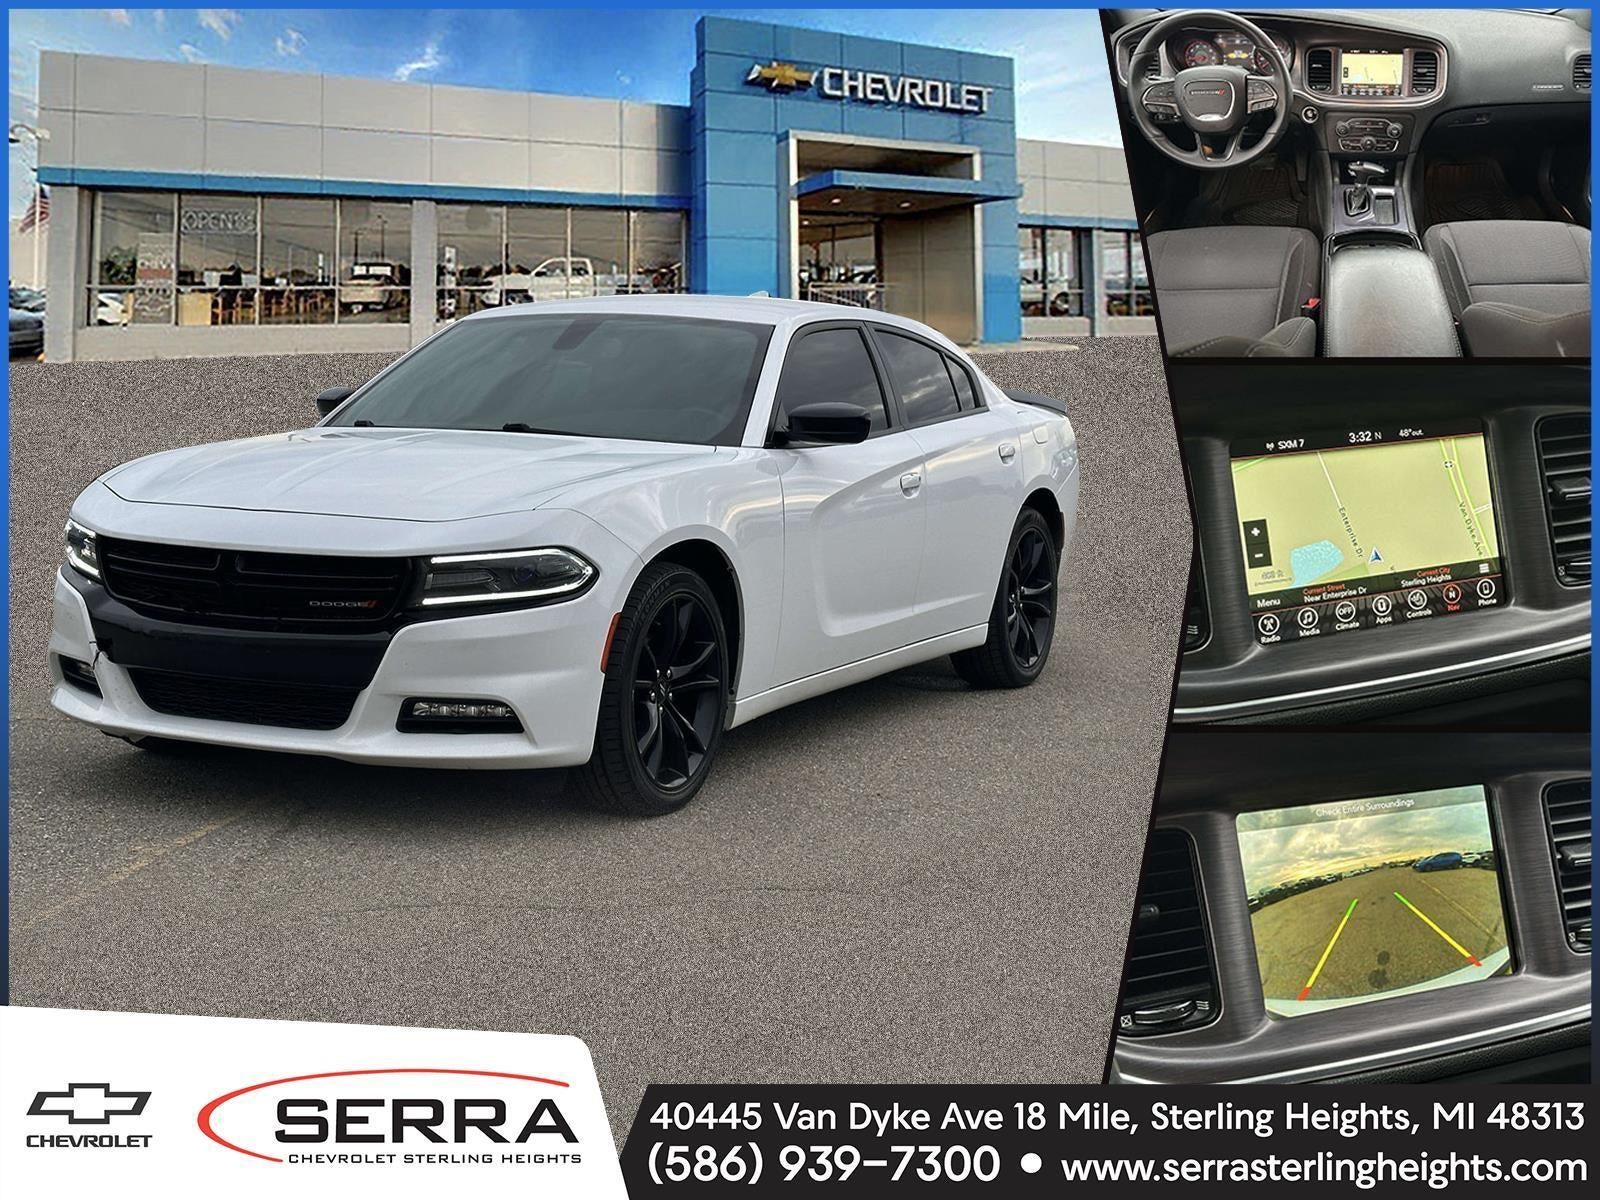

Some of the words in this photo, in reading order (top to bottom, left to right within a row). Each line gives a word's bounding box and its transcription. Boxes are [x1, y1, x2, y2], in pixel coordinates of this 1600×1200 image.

[823, 67, 993, 112] CHEVROLET
[1348, 430, 1373, 443] 3:32
[1374, 432, 1382, 440] N
[1277, 440, 1298, 450] SXM
[1299, 438, 1305, 448] 7
[1338, 506, 1358, 547] Enterprise
[1356, 547, 1363, 558] Dr
[1459, 501, 1467, 517] Van
[1464, 518, 1476, 539] Dyke
[1474, 542, 1483, 556] Ave
[1439, 567, 1451, 576] City
[1401, 576, 1426, 588] Sterling
[1426, 573, 1452, 585] Heights
[1326, 583, 1345, 592] Street
[1303, 594, 1321, 603] Near
[1322, 588, 1358, 601] Enterprise
[1358, 586, 1367, 594] Dr
[1256, 598, 1281, 608] Menu
[1478, 598, 1497, 607] Phone
[1339, 606, 1352, 615] OFF
[1406, 608, 1432, 619] Controls
[1335, 620, 1360, 631] Climate
[1376, 615, 1392, 625] Apps
[1299, 627, 1321, 638] Media
[1260, 634, 1281, 644] Radio
[1315, 806, 1341, 817] Check
[1342, 805, 1365, 815] Entire
[1366, 798, 1415, 812] Surroundings
